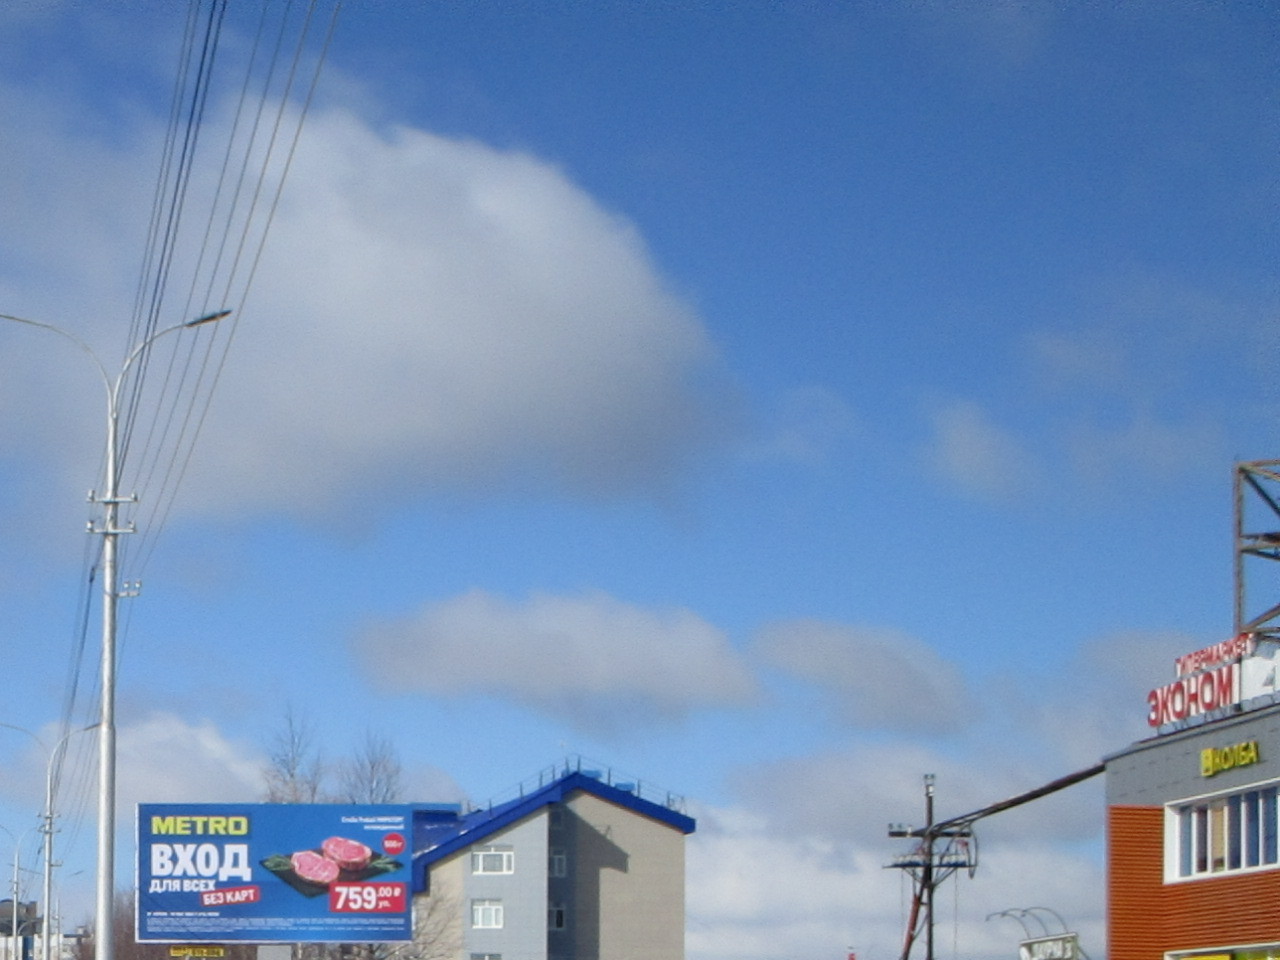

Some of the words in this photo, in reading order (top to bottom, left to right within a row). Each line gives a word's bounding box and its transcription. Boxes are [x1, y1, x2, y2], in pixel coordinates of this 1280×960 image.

[1147, 664, 1241, 727] ЭКОНОМ
[151, 816, 248, 835] METRO
[151, 843, 252, 882] ВХОД
[149, 879, 181, 893] ДЛЯ
[182, 879, 216, 892] ВСЕХ
[203, 893, 223, 906] БЕЗ
[224, 889, 255, 903] КАРТ
[335, 886, 377, 910] 759
